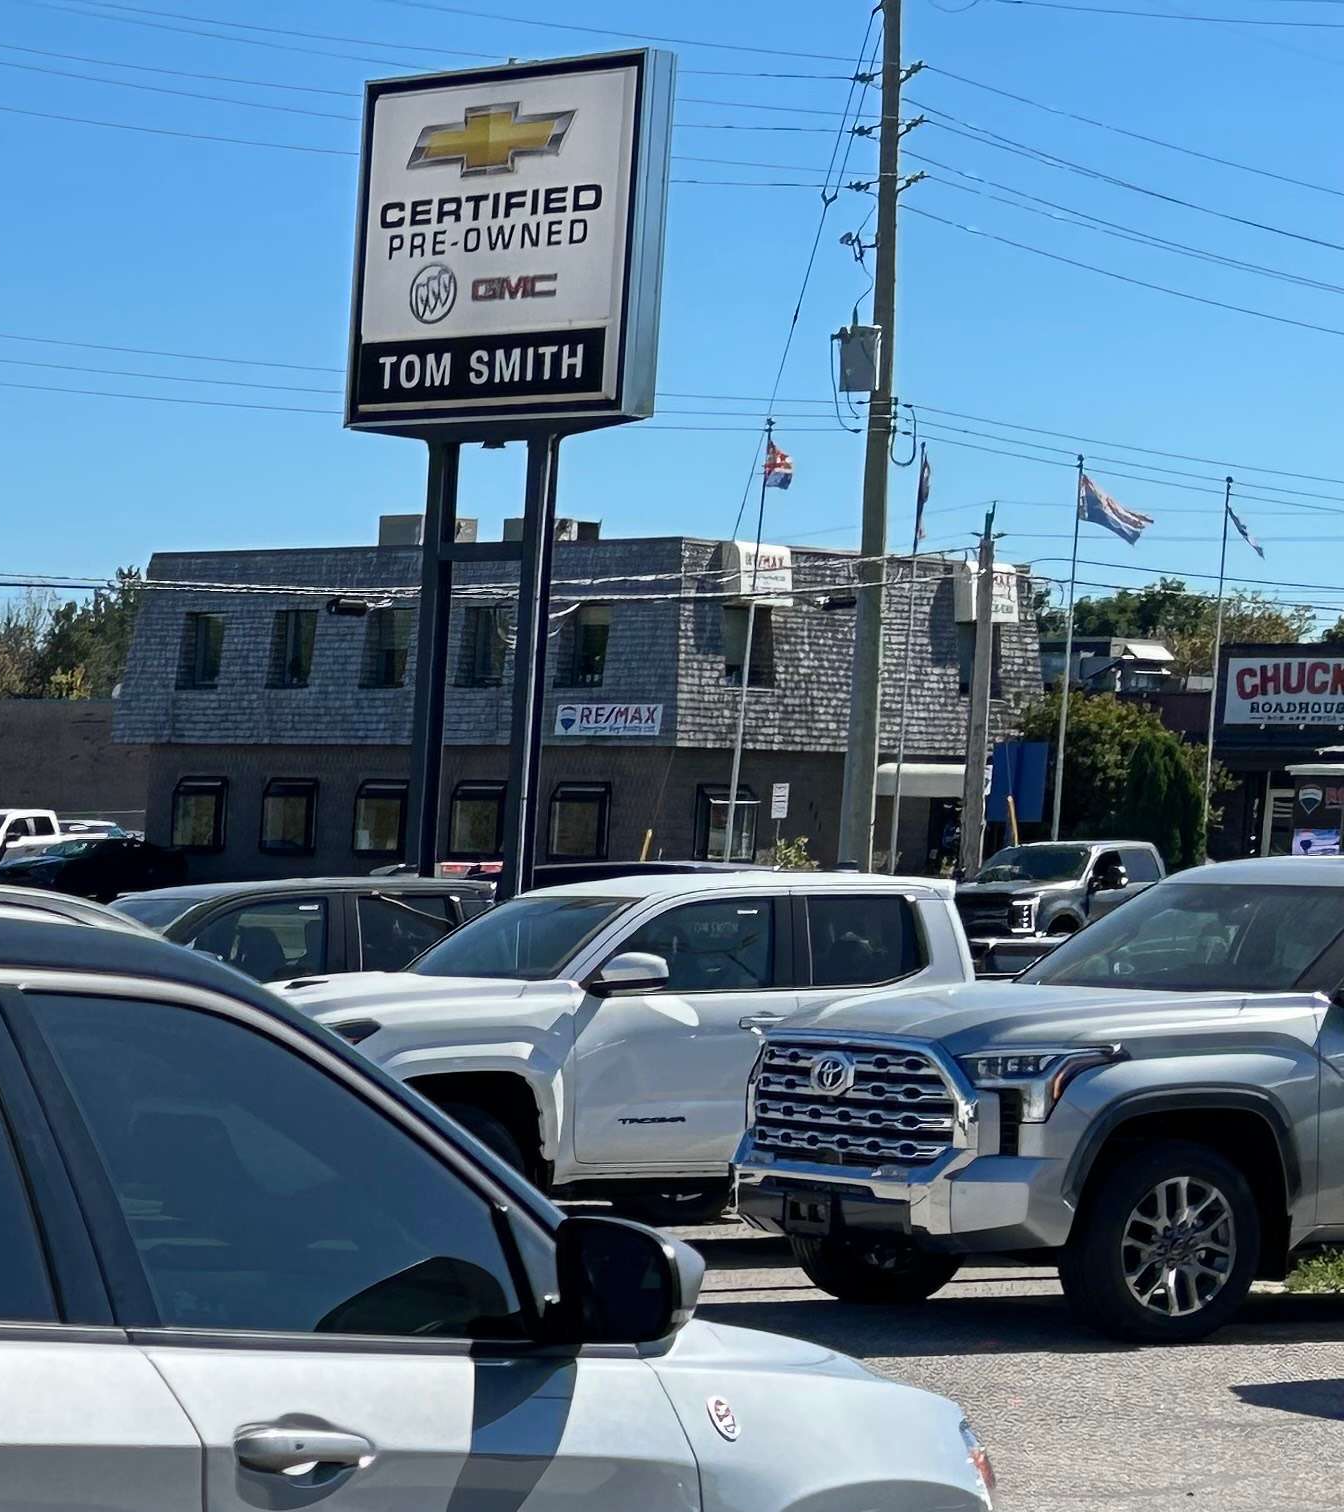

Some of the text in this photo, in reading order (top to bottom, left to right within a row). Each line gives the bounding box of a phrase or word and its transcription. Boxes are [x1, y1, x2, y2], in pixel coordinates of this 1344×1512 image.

[380, 183, 603, 229] CERTIFIED
[388, 217, 589, 261] PRE-OWNED
[470, 272, 558, 302] GMC
[378, 342, 585, 390] TOM SMITH
[579, 706, 658, 725] RE/MAX
